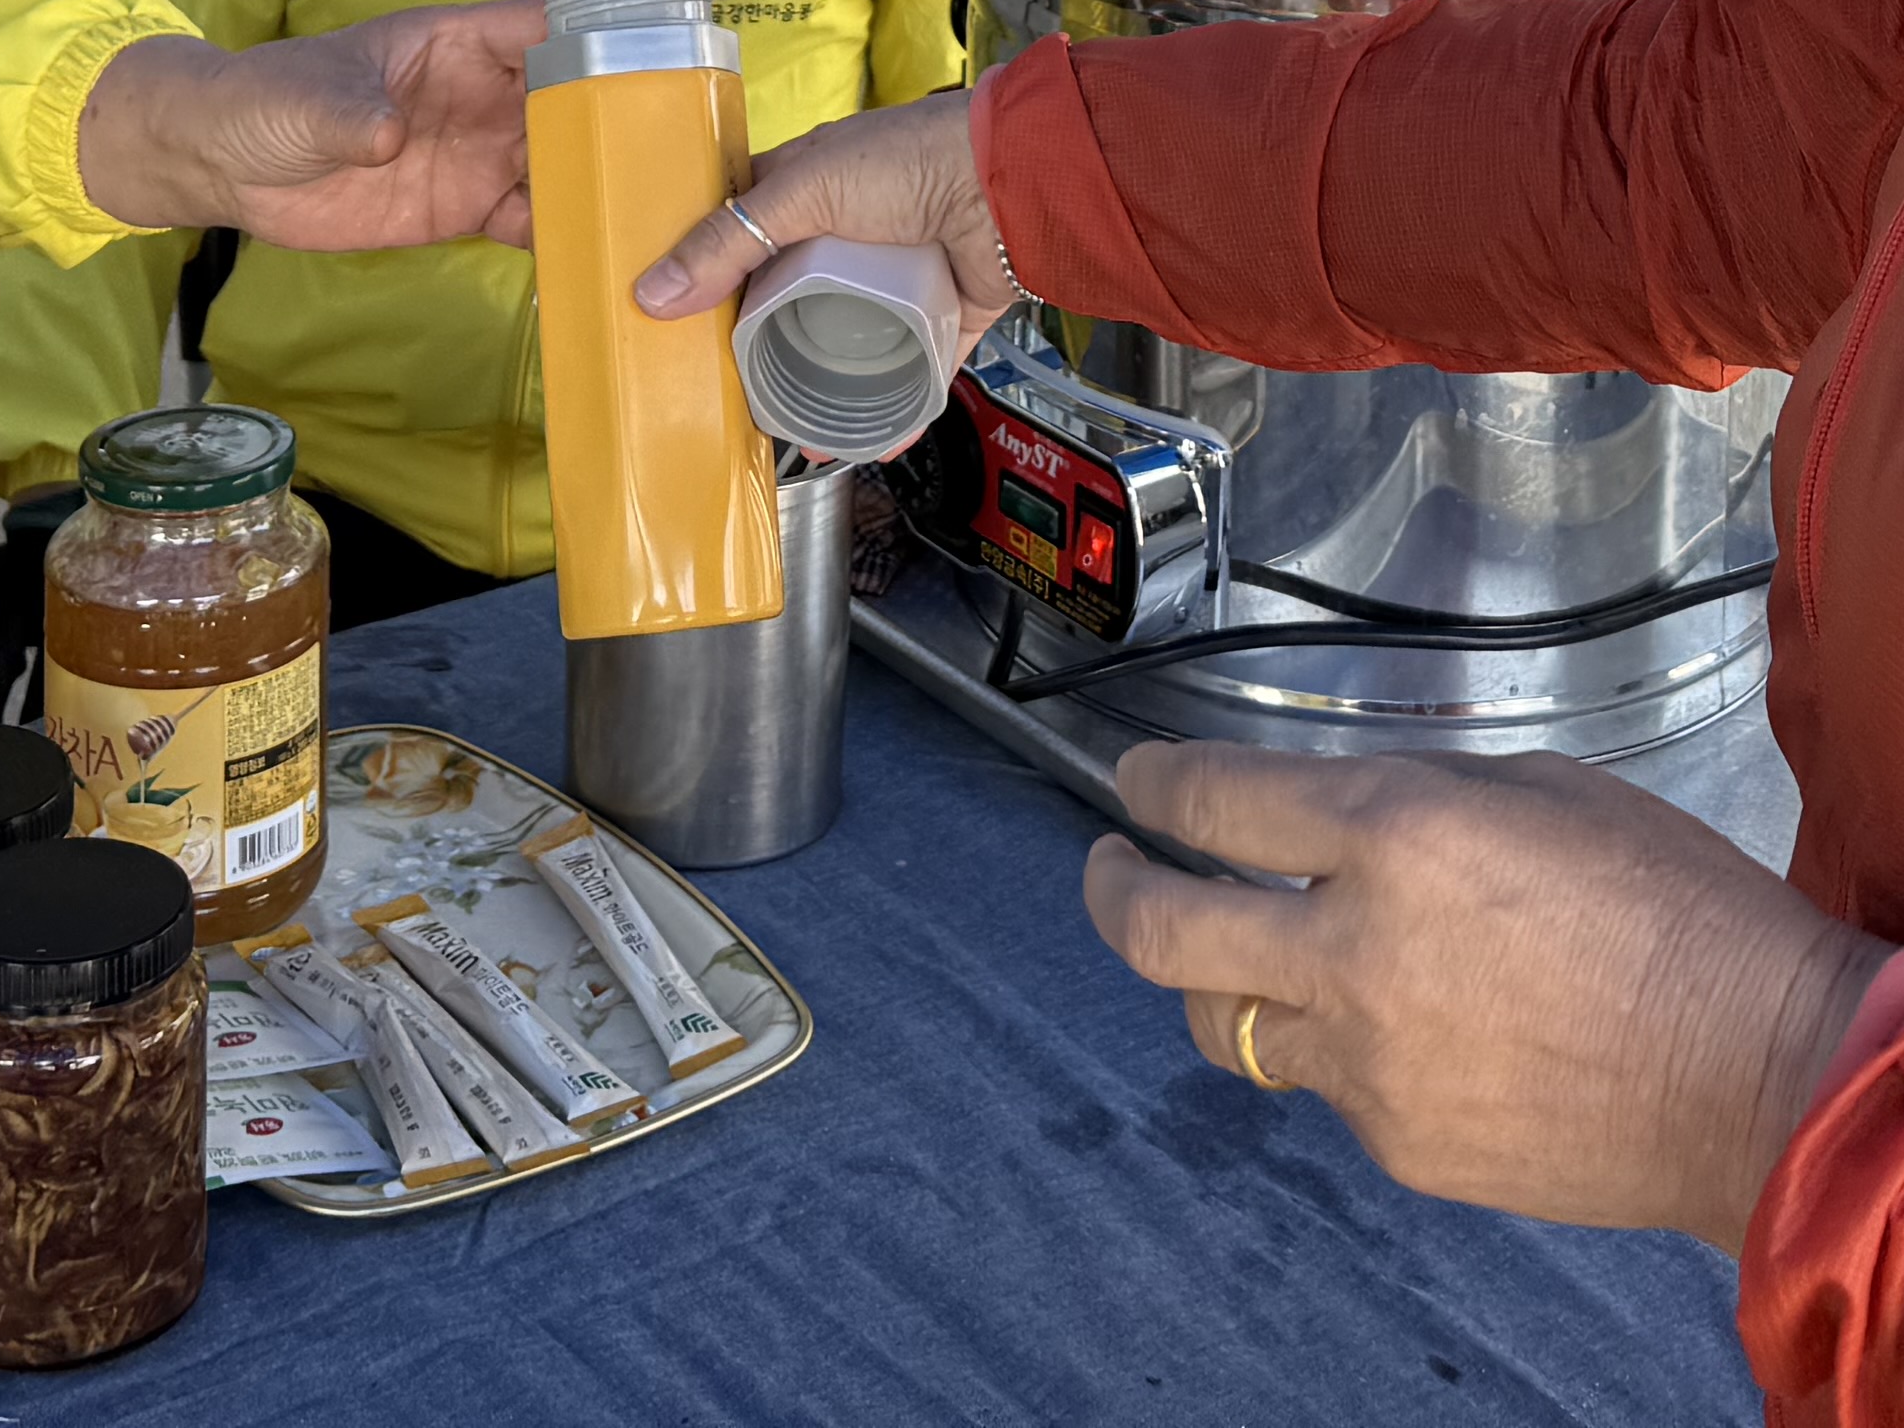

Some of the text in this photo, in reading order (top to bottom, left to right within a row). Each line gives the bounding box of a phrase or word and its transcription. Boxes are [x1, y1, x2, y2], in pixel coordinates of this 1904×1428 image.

[988, 421, 1067, 480] AnyST
[129, 490, 155, 503] OPEN
[560, 851, 613, 907] Maxim
[412, 921, 480, 975] Maxim
[207, 1091, 311, 1117] 현미녹
